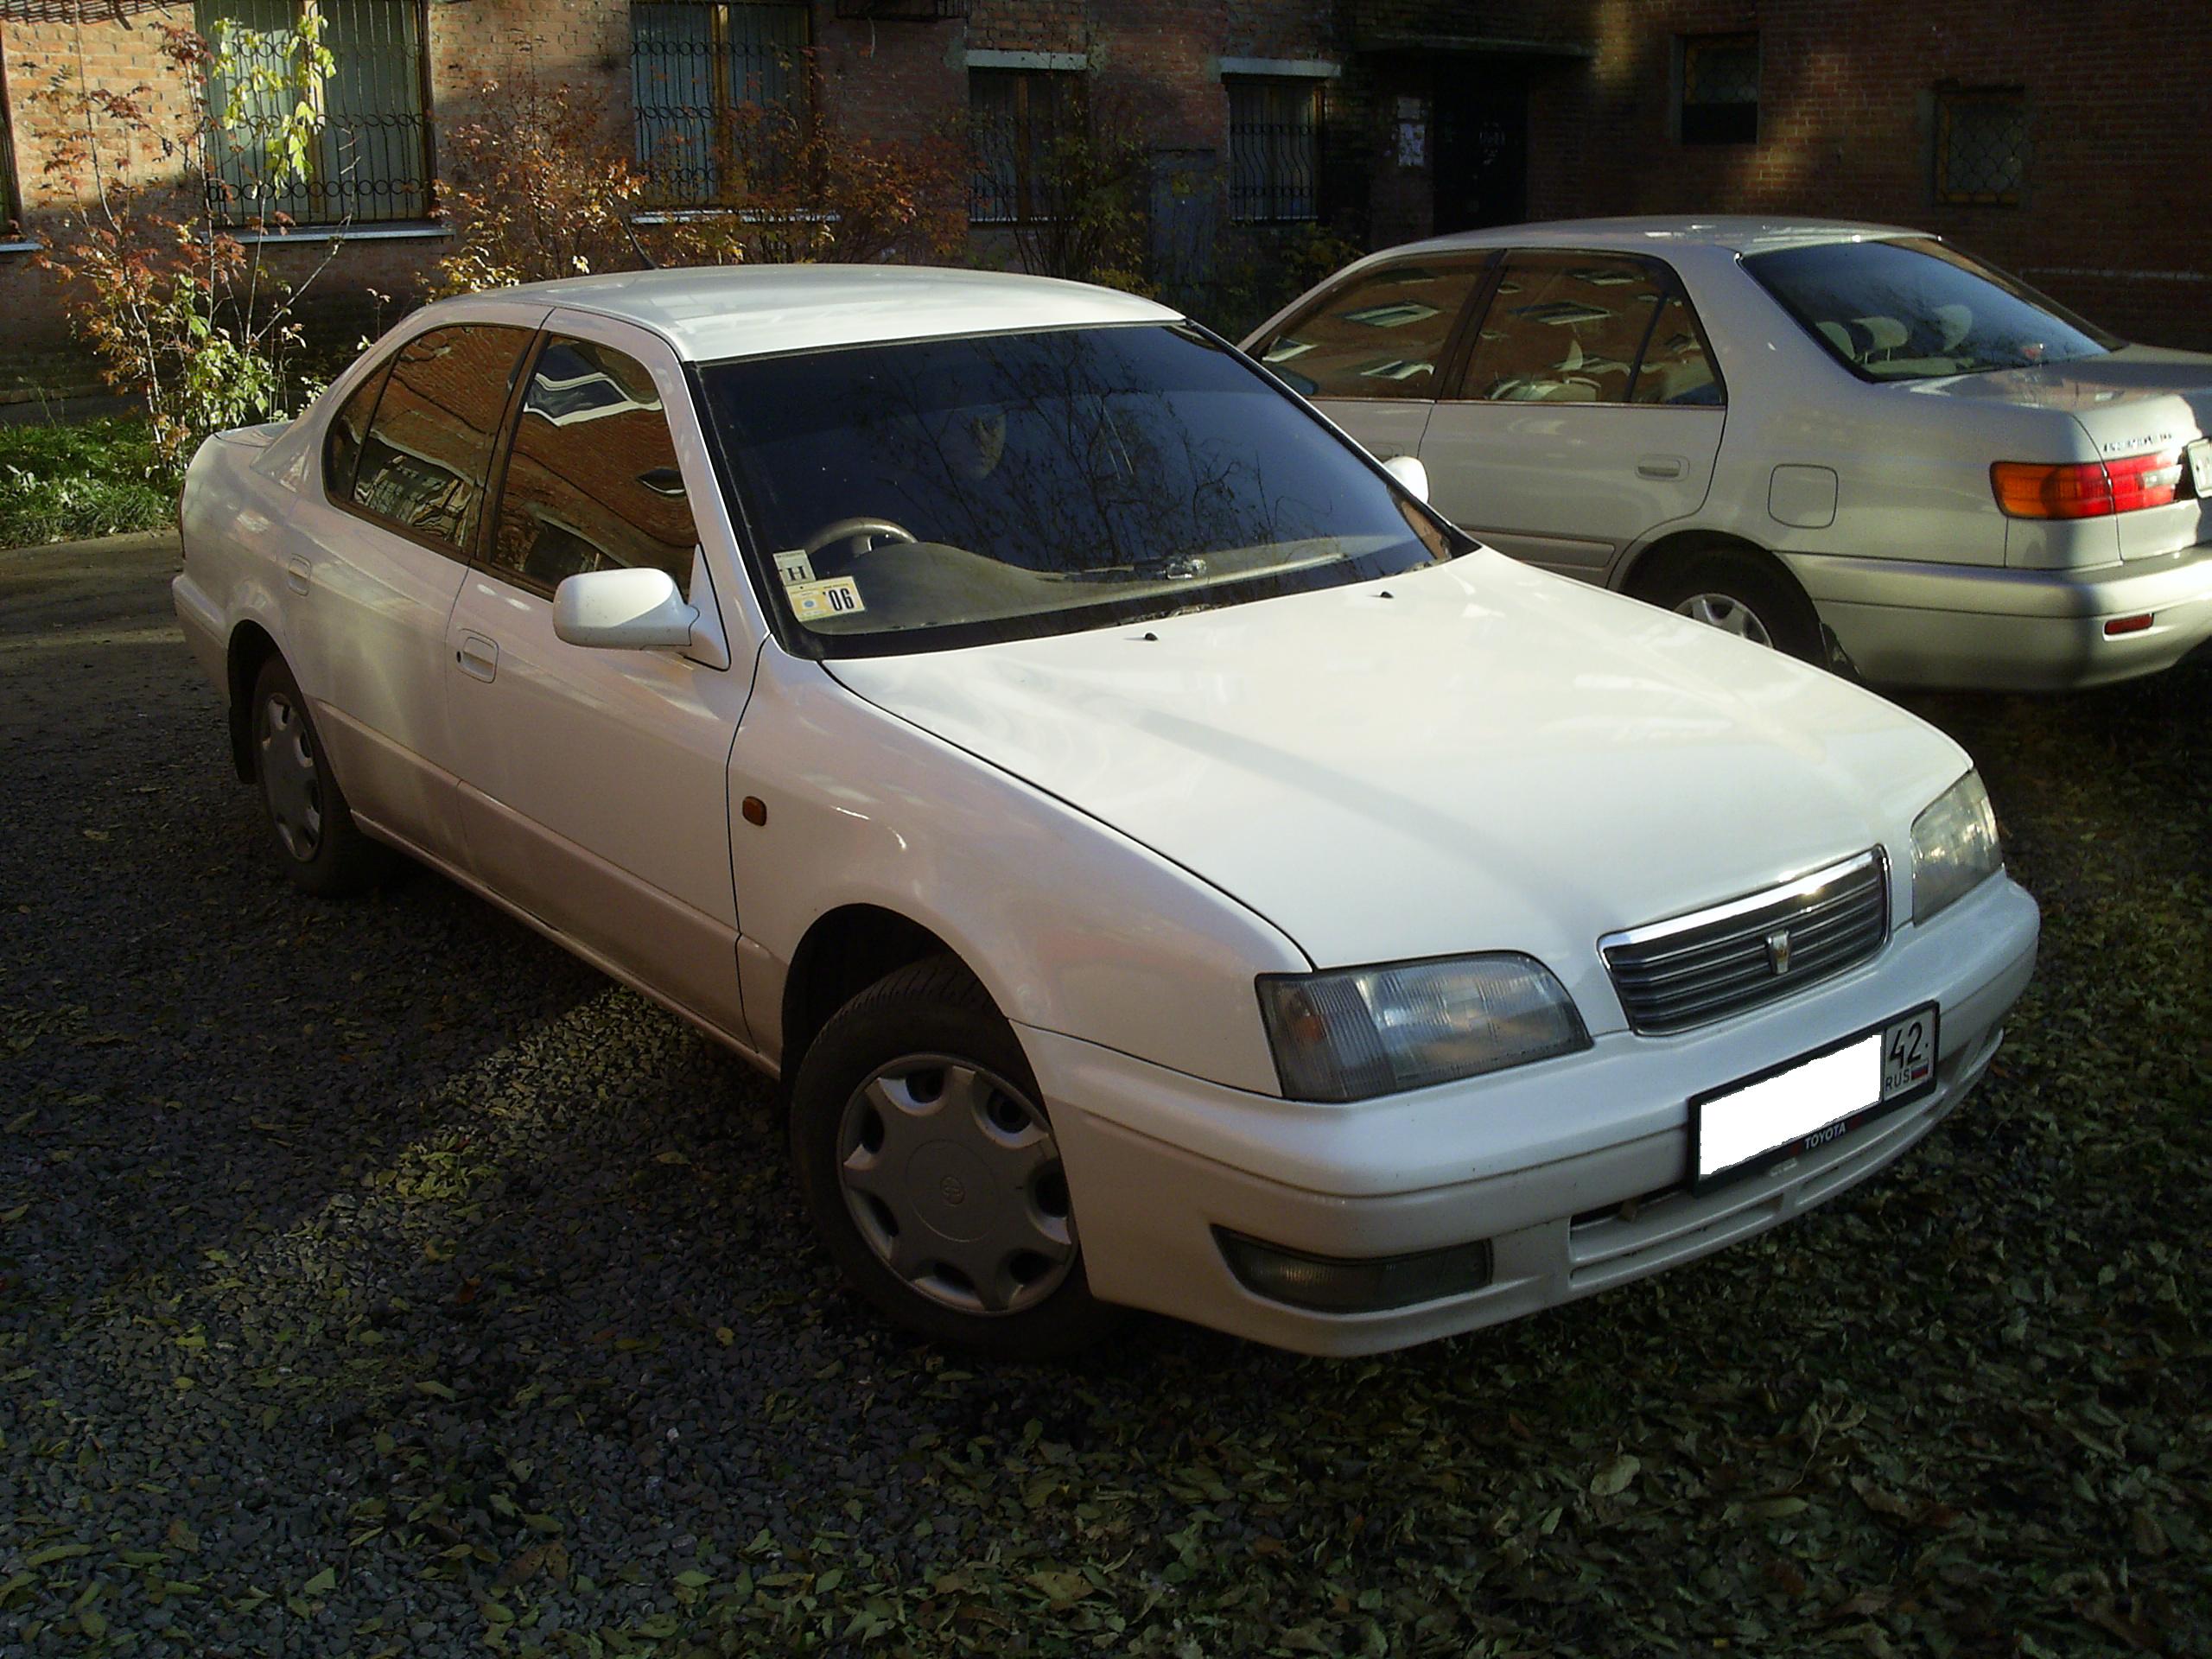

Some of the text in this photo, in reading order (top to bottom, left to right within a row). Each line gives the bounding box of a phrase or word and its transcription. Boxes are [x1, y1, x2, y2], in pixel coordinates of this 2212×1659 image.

[1890, 1022, 1923, 1069] 42
[1885, 1069, 1910, 1091] RUS
[1805, 1122, 1846, 1149] TOYOTA
